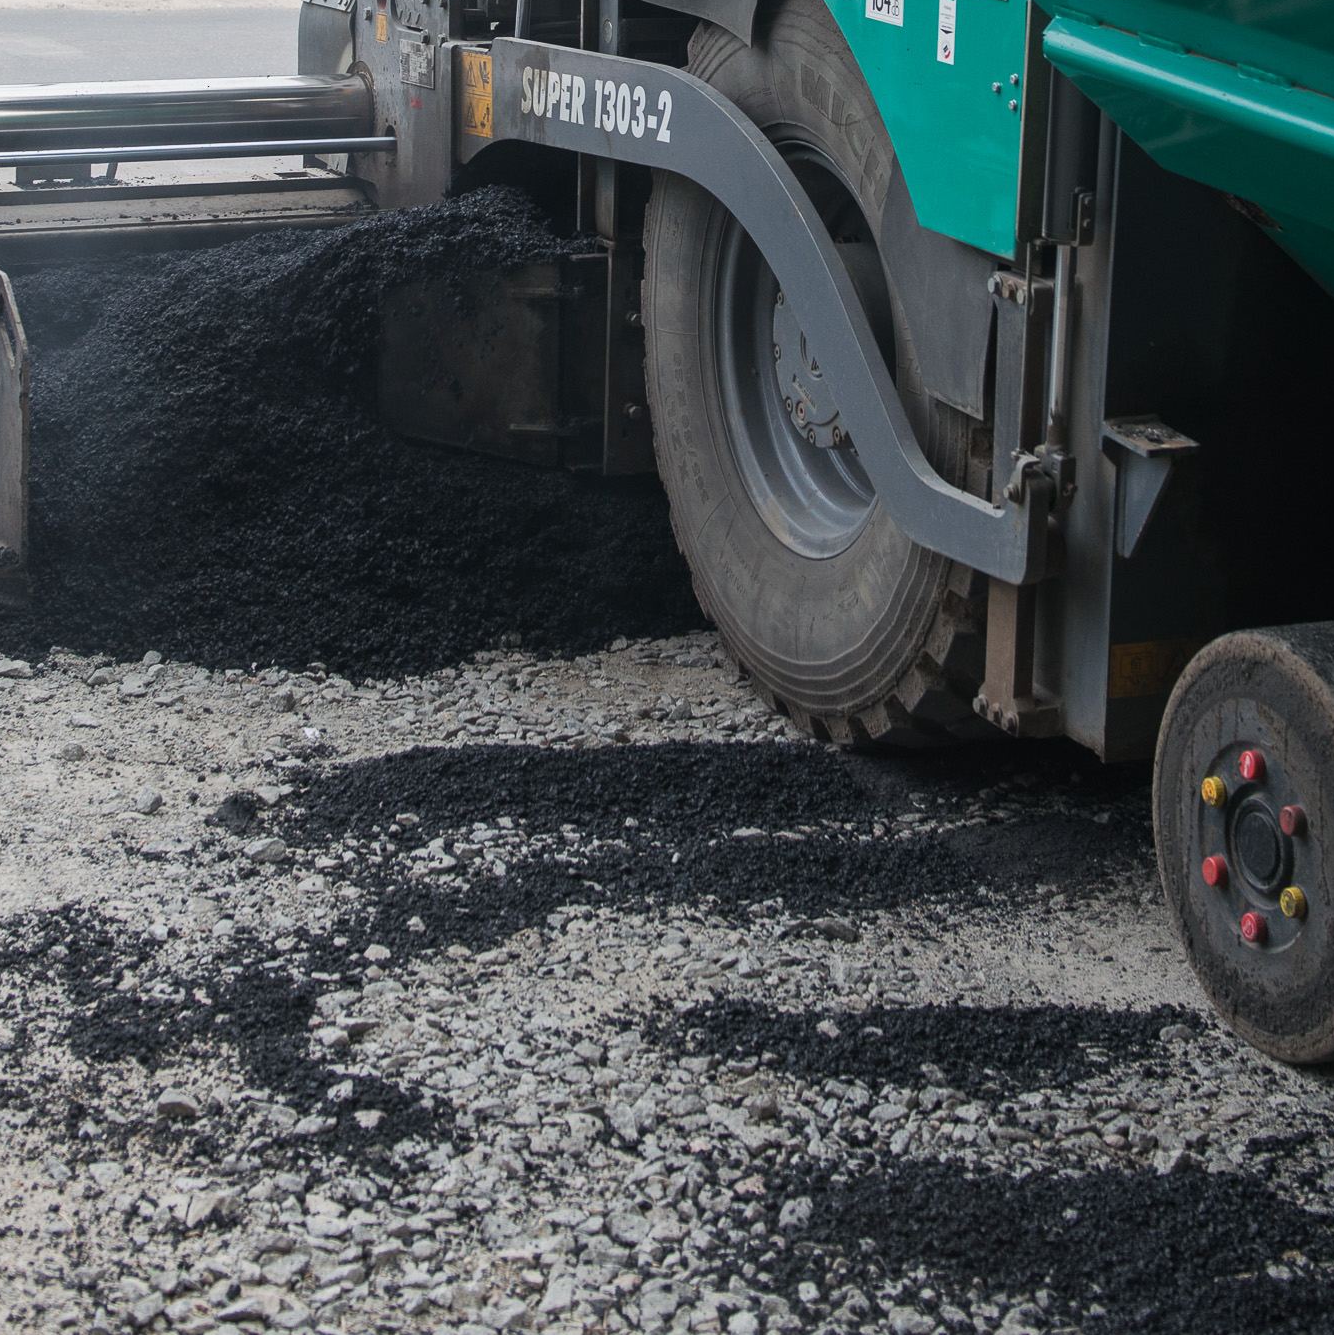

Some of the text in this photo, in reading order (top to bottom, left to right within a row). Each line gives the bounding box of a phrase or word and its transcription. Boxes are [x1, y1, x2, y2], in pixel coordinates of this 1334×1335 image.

[891, 0, 900, 17] dB
[520, 65, 673, 144] SUPER 1303-2
